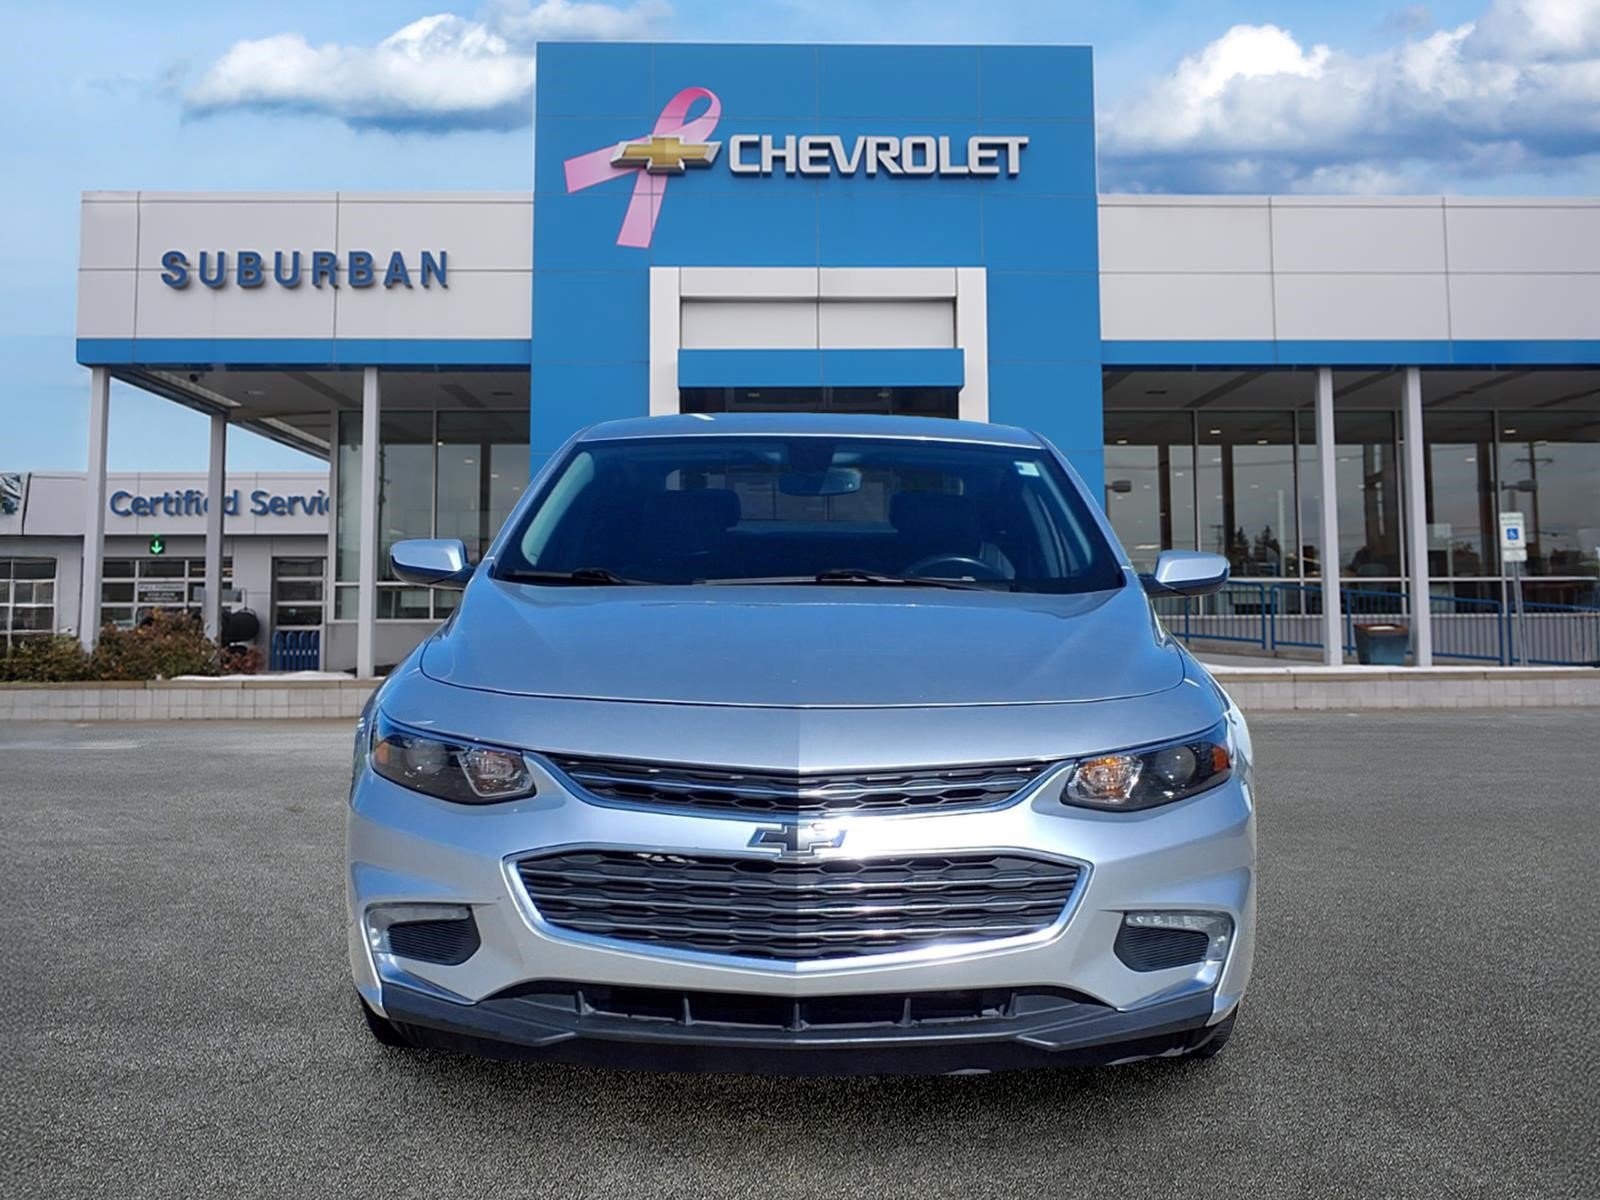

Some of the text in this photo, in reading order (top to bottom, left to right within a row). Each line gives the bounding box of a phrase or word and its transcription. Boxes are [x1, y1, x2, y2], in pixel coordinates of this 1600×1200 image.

[729, 134, 1029, 174] CHEVROLET
[161, 251, 448, 288] SUBURBAN
[109, 489, 240, 517] Certifid
